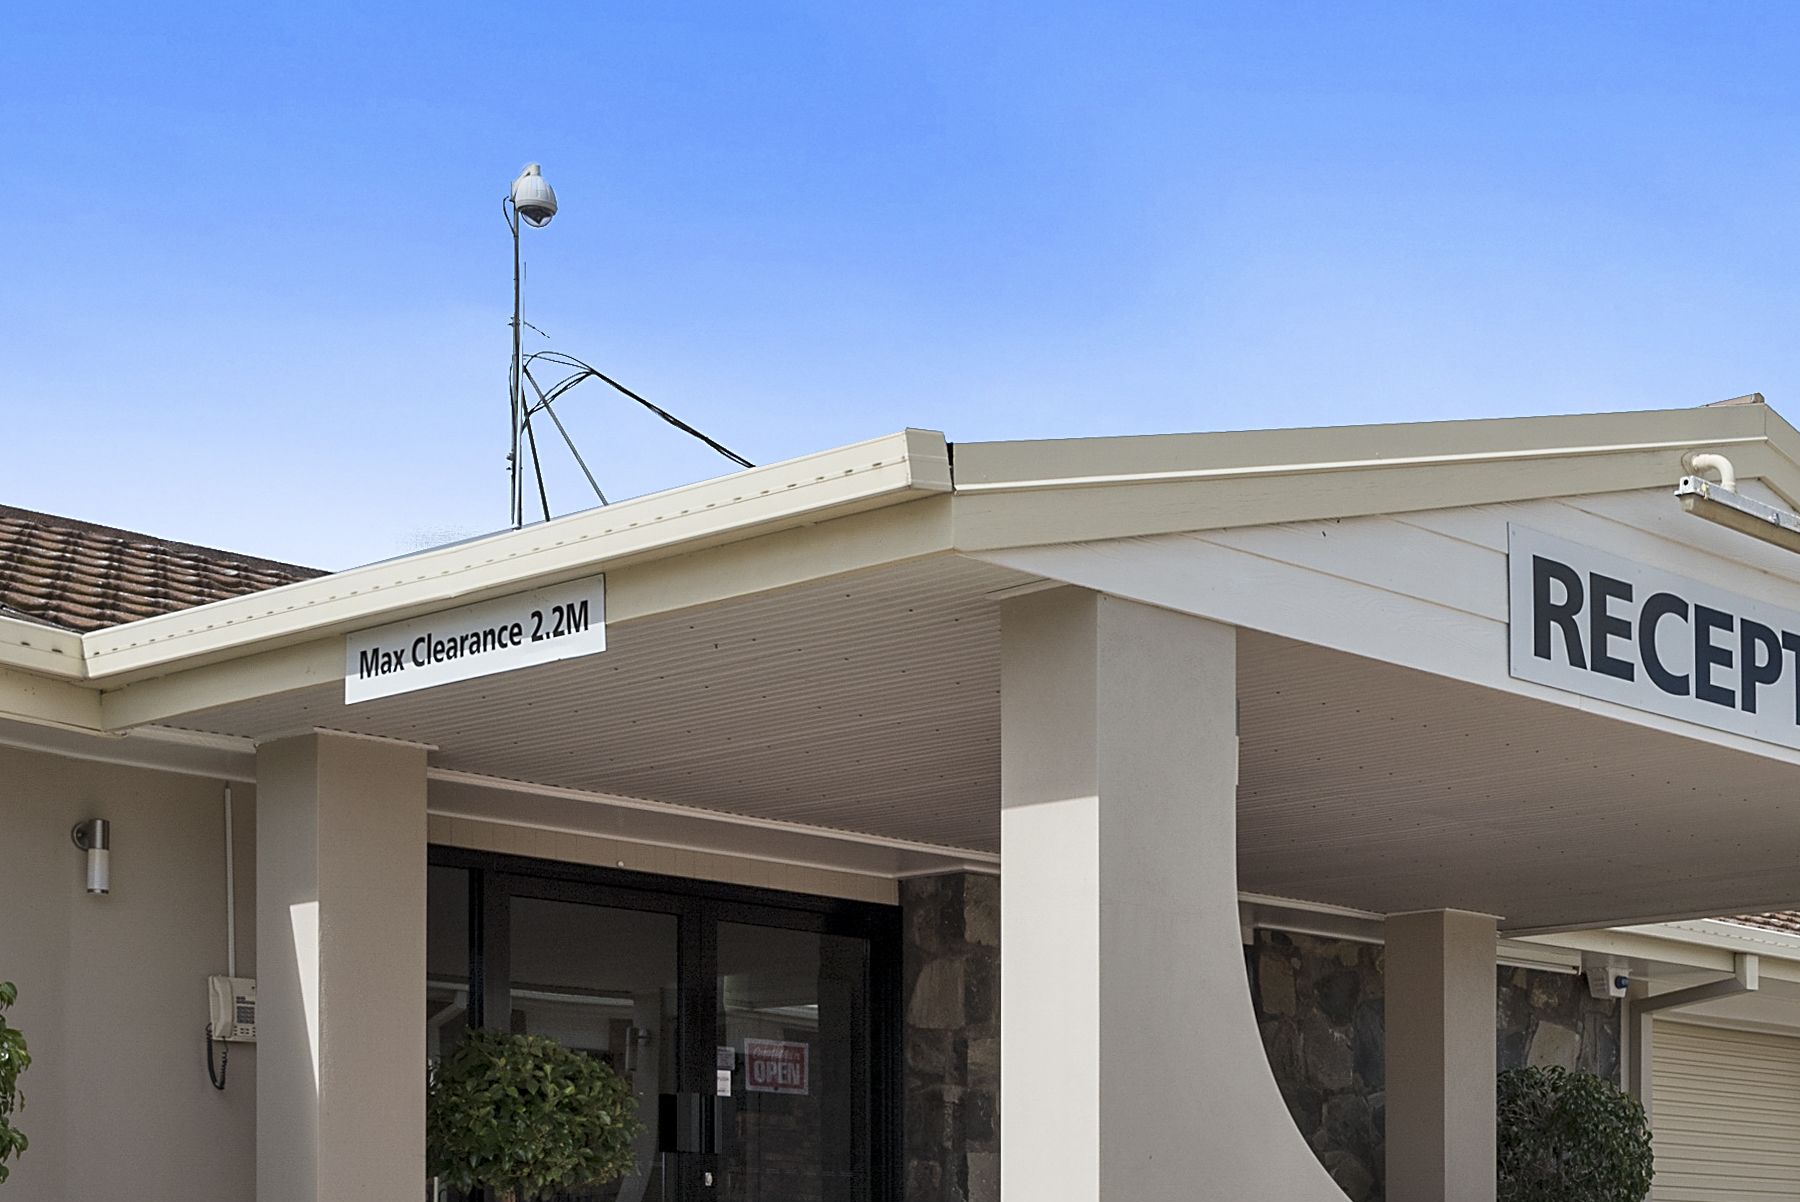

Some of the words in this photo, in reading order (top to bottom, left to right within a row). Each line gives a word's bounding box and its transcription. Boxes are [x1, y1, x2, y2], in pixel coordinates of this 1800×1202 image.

[359, 647, 406, 680] Max
[411, 621, 523, 667] Clearance
[530, 599, 590, 643] 2.2M
[753, 1060, 801, 1085] OPEN
